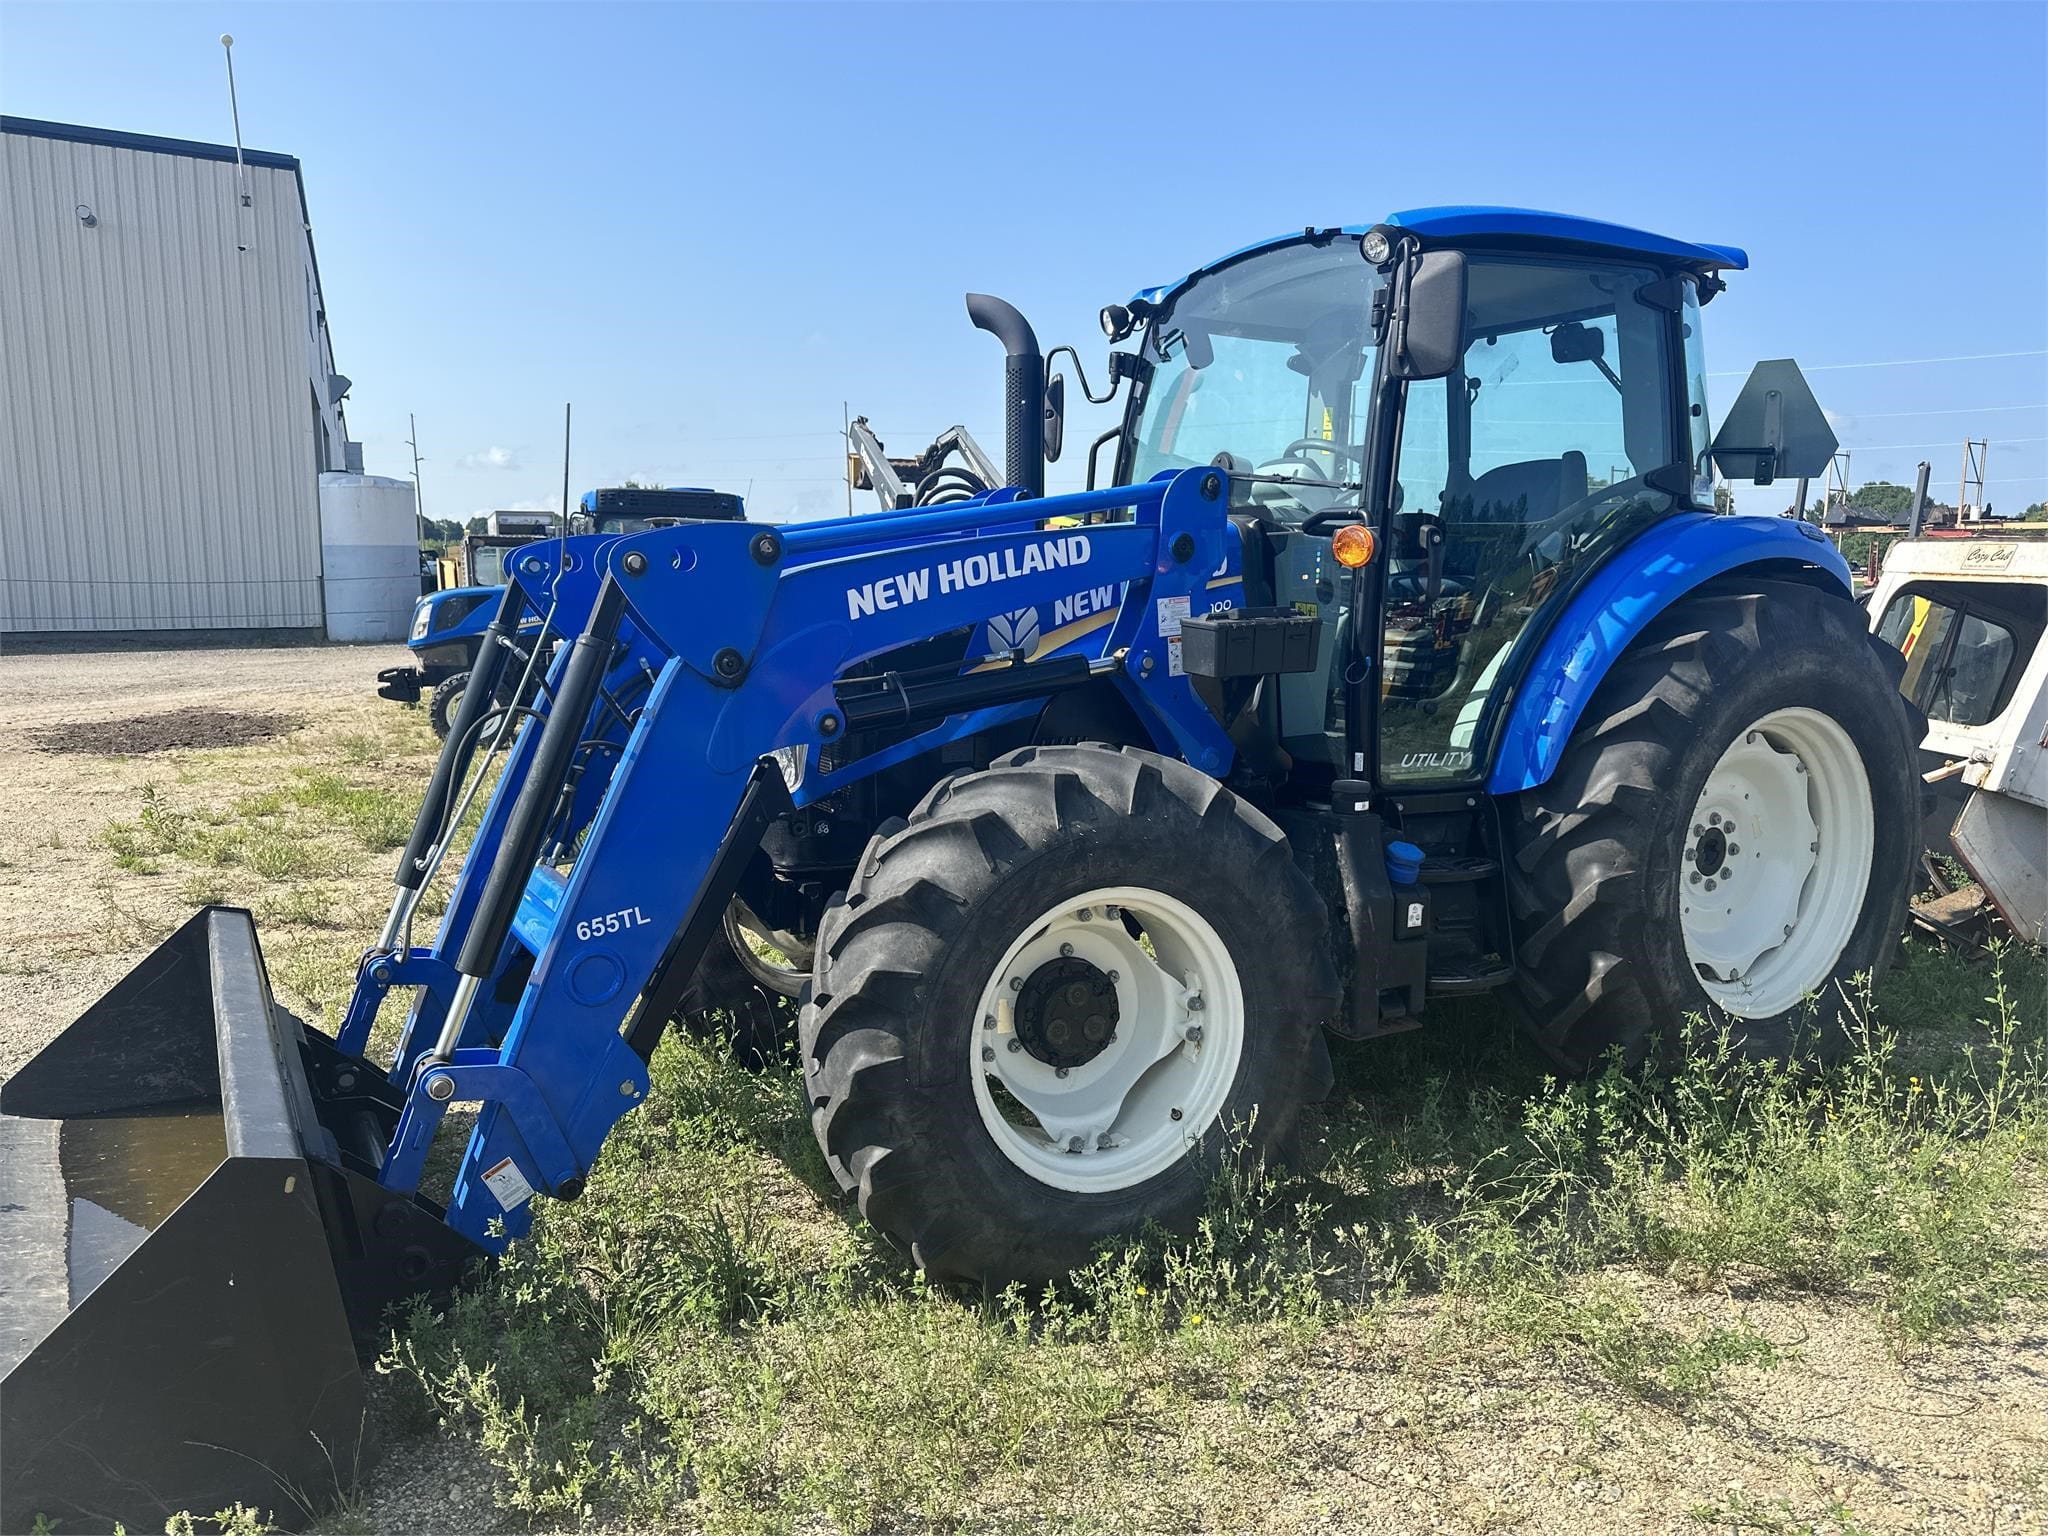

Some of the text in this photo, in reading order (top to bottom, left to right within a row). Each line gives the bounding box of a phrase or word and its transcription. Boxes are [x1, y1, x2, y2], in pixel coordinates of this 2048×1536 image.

[1967, 548, 1989, 563] Cozy
[847, 535, 1091, 620] NEW HOLLAND
[1054, 584, 1113, 625] NEW
[1210, 600, 1232, 614] 100
[1400, 751, 1472, 768] UTILITY
[576, 906, 651, 941] 655TL
